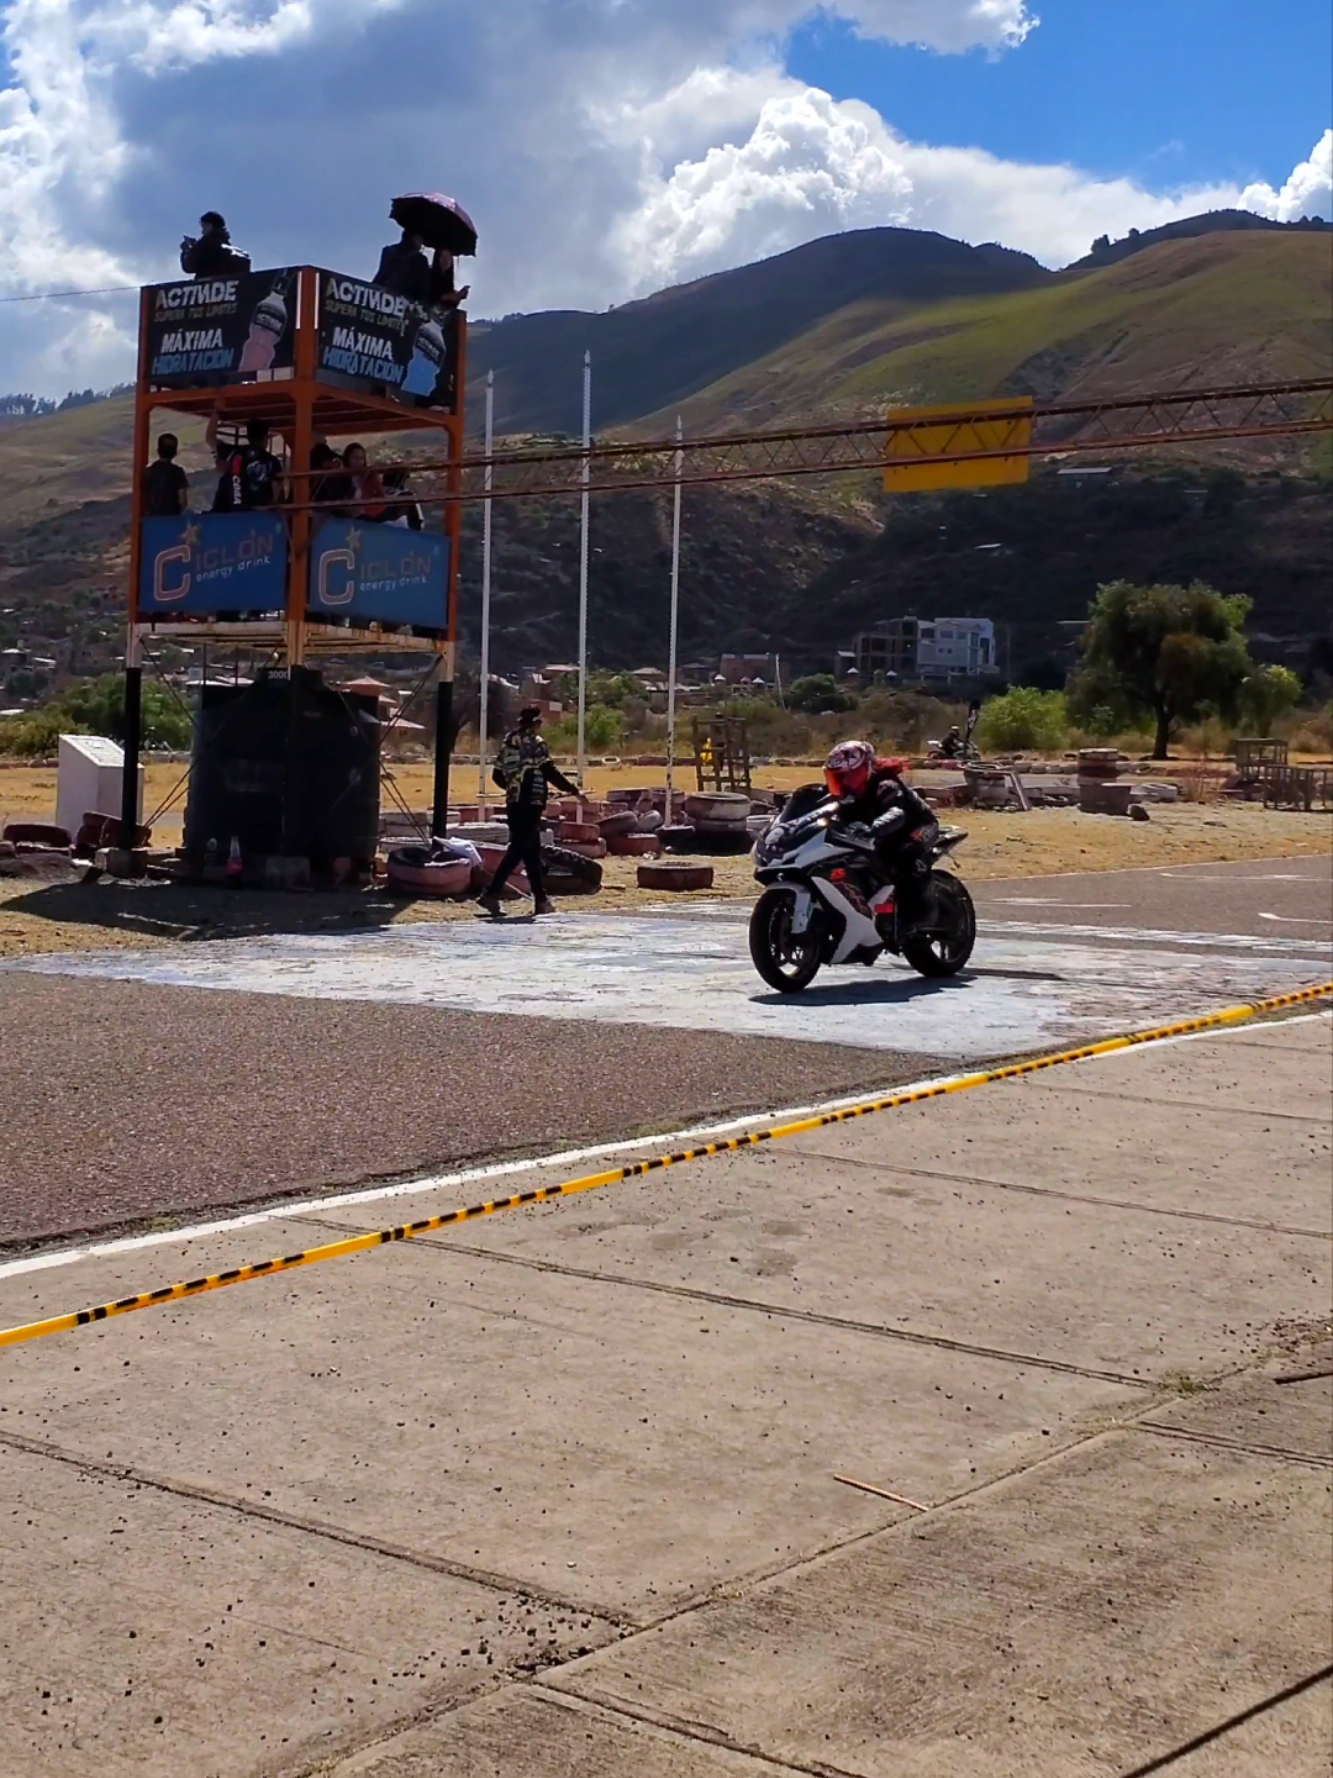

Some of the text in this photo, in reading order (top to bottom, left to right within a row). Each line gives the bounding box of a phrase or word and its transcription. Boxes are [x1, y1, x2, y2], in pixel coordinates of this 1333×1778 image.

[161, 328, 222, 353] MÁXIMA
[332, 326, 393, 360] MÁXIMA
[196, 556, 271, 583] energy drink
[359, 575, 427, 592] energy drink
